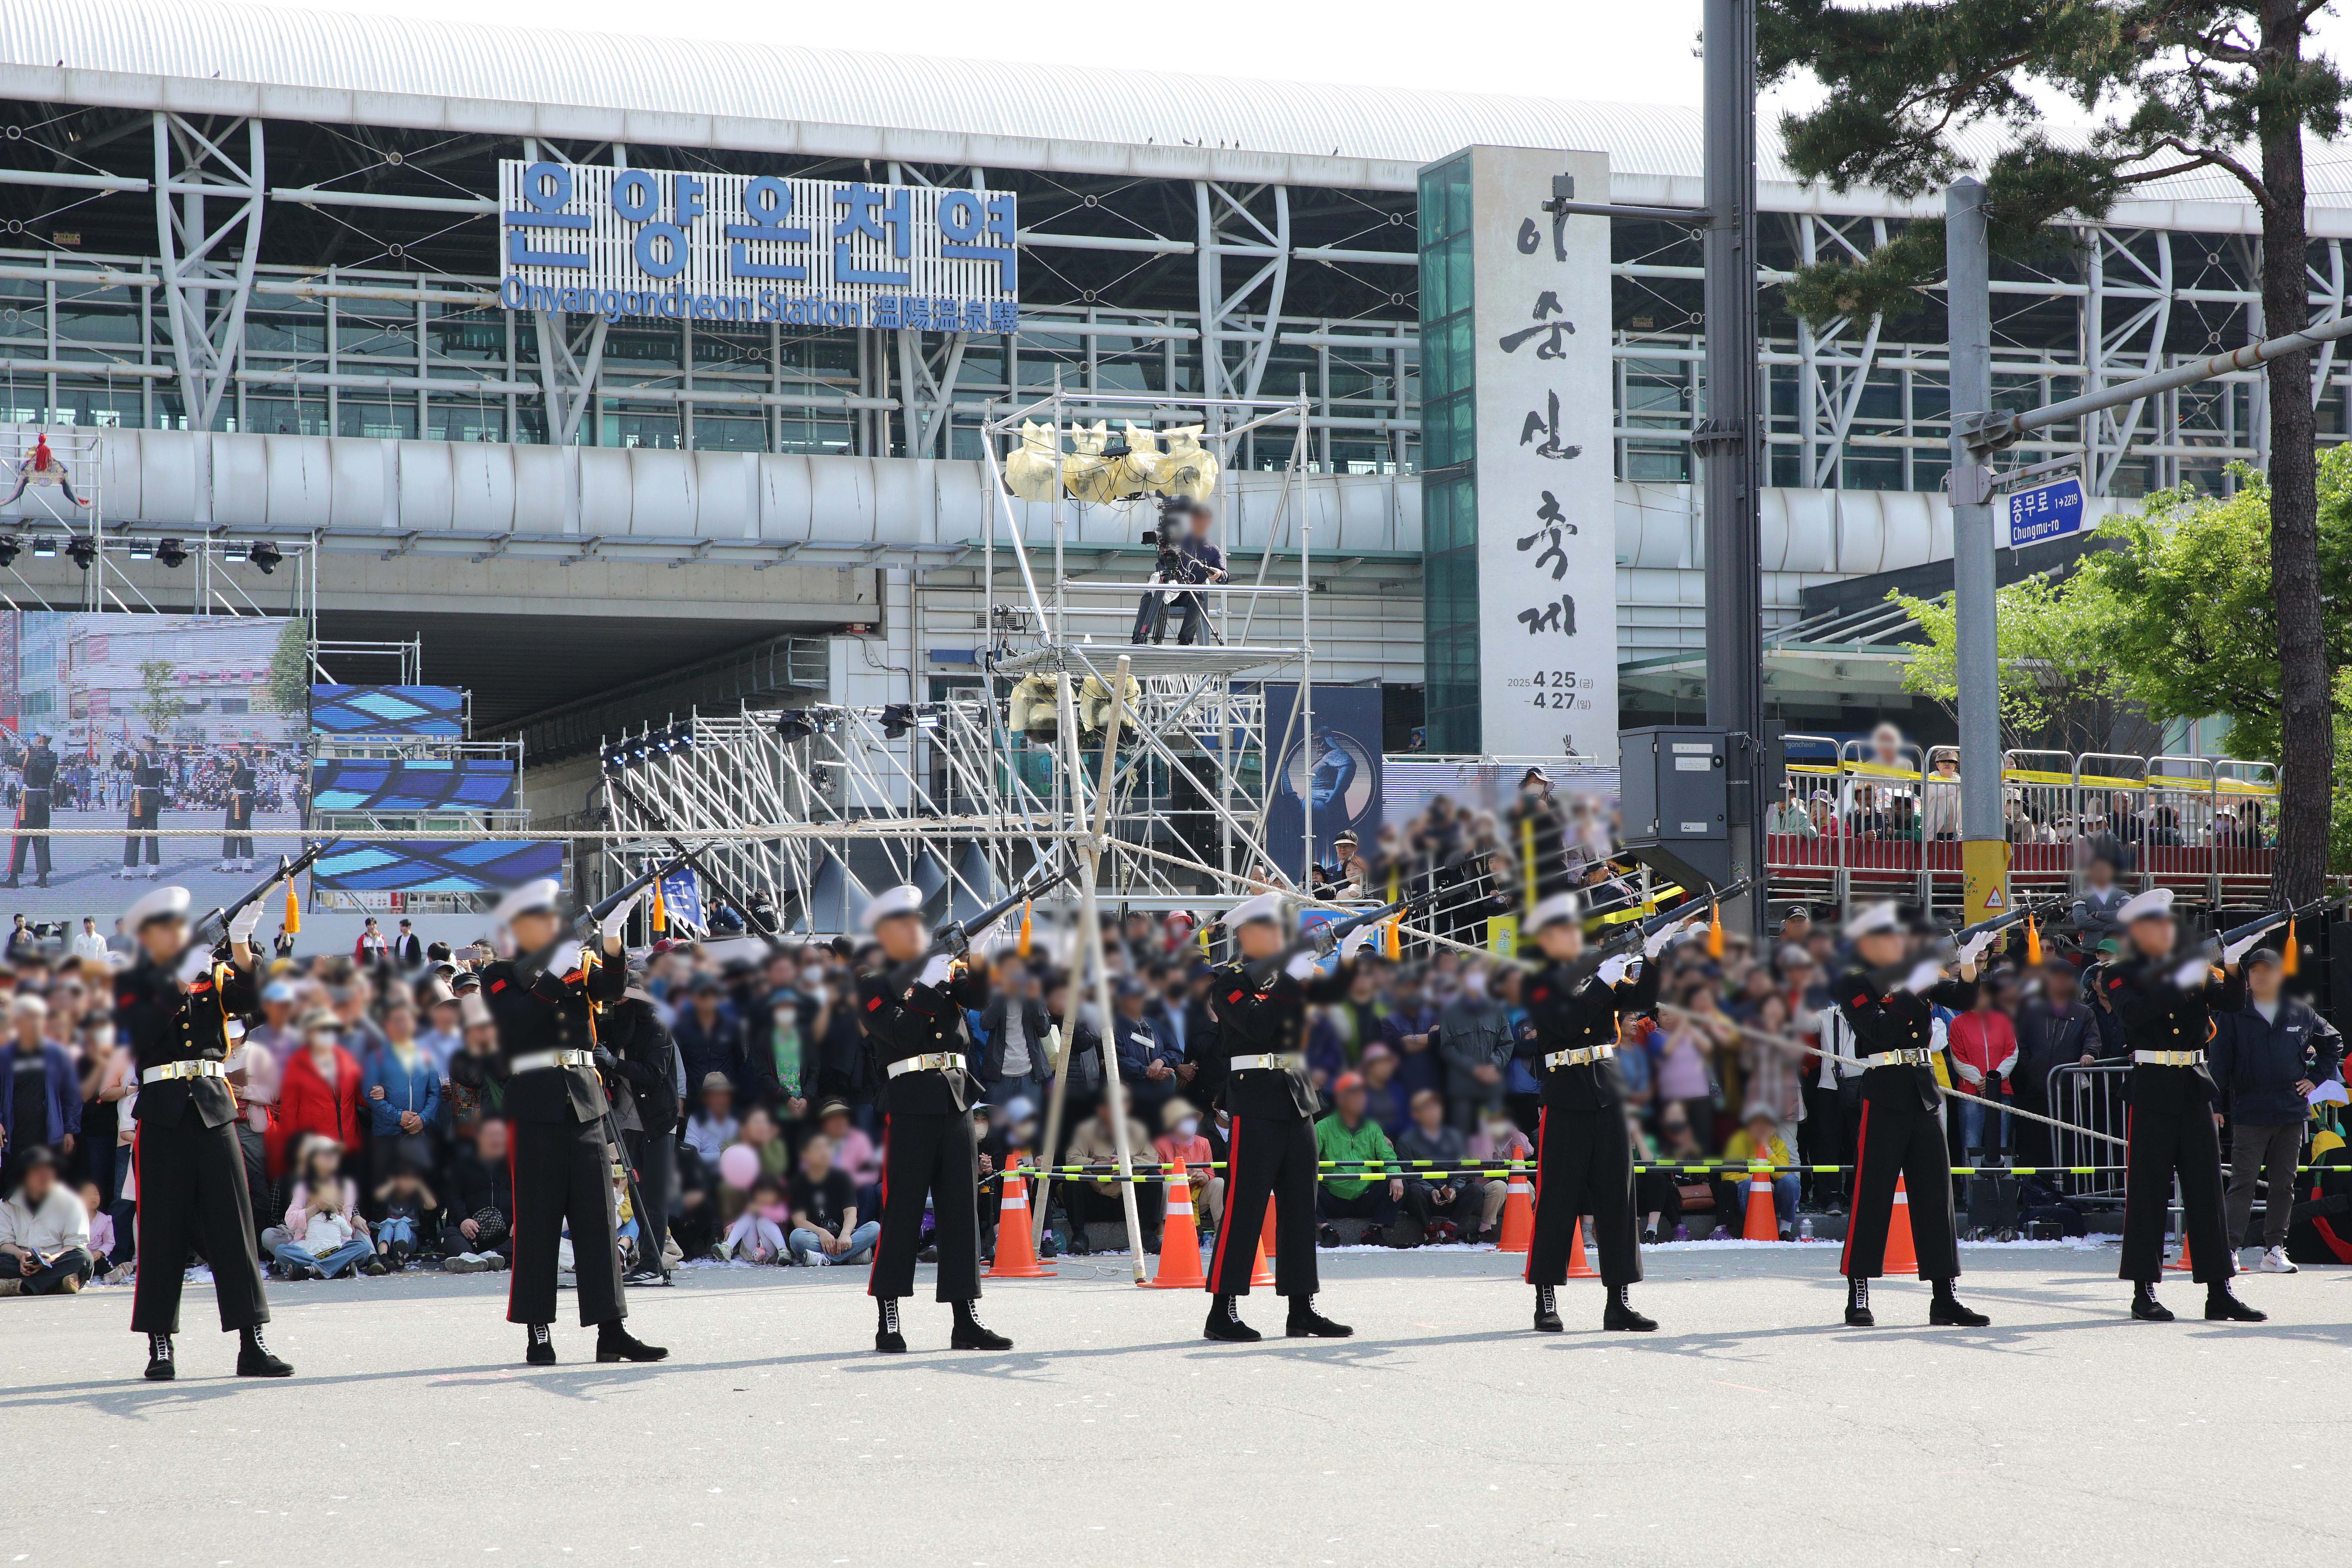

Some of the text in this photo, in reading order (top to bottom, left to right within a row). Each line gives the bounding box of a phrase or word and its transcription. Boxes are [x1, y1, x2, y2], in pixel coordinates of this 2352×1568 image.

[505, 161, 1017, 292] 온양온천역
[501, 275, 863, 327] Onyangoncheon Station
[2012, 491, 2049, 524] 충무로
[2064, 493, 2078, 507] 2219
[2013, 519, 2059, 541] Chungmu-ro
